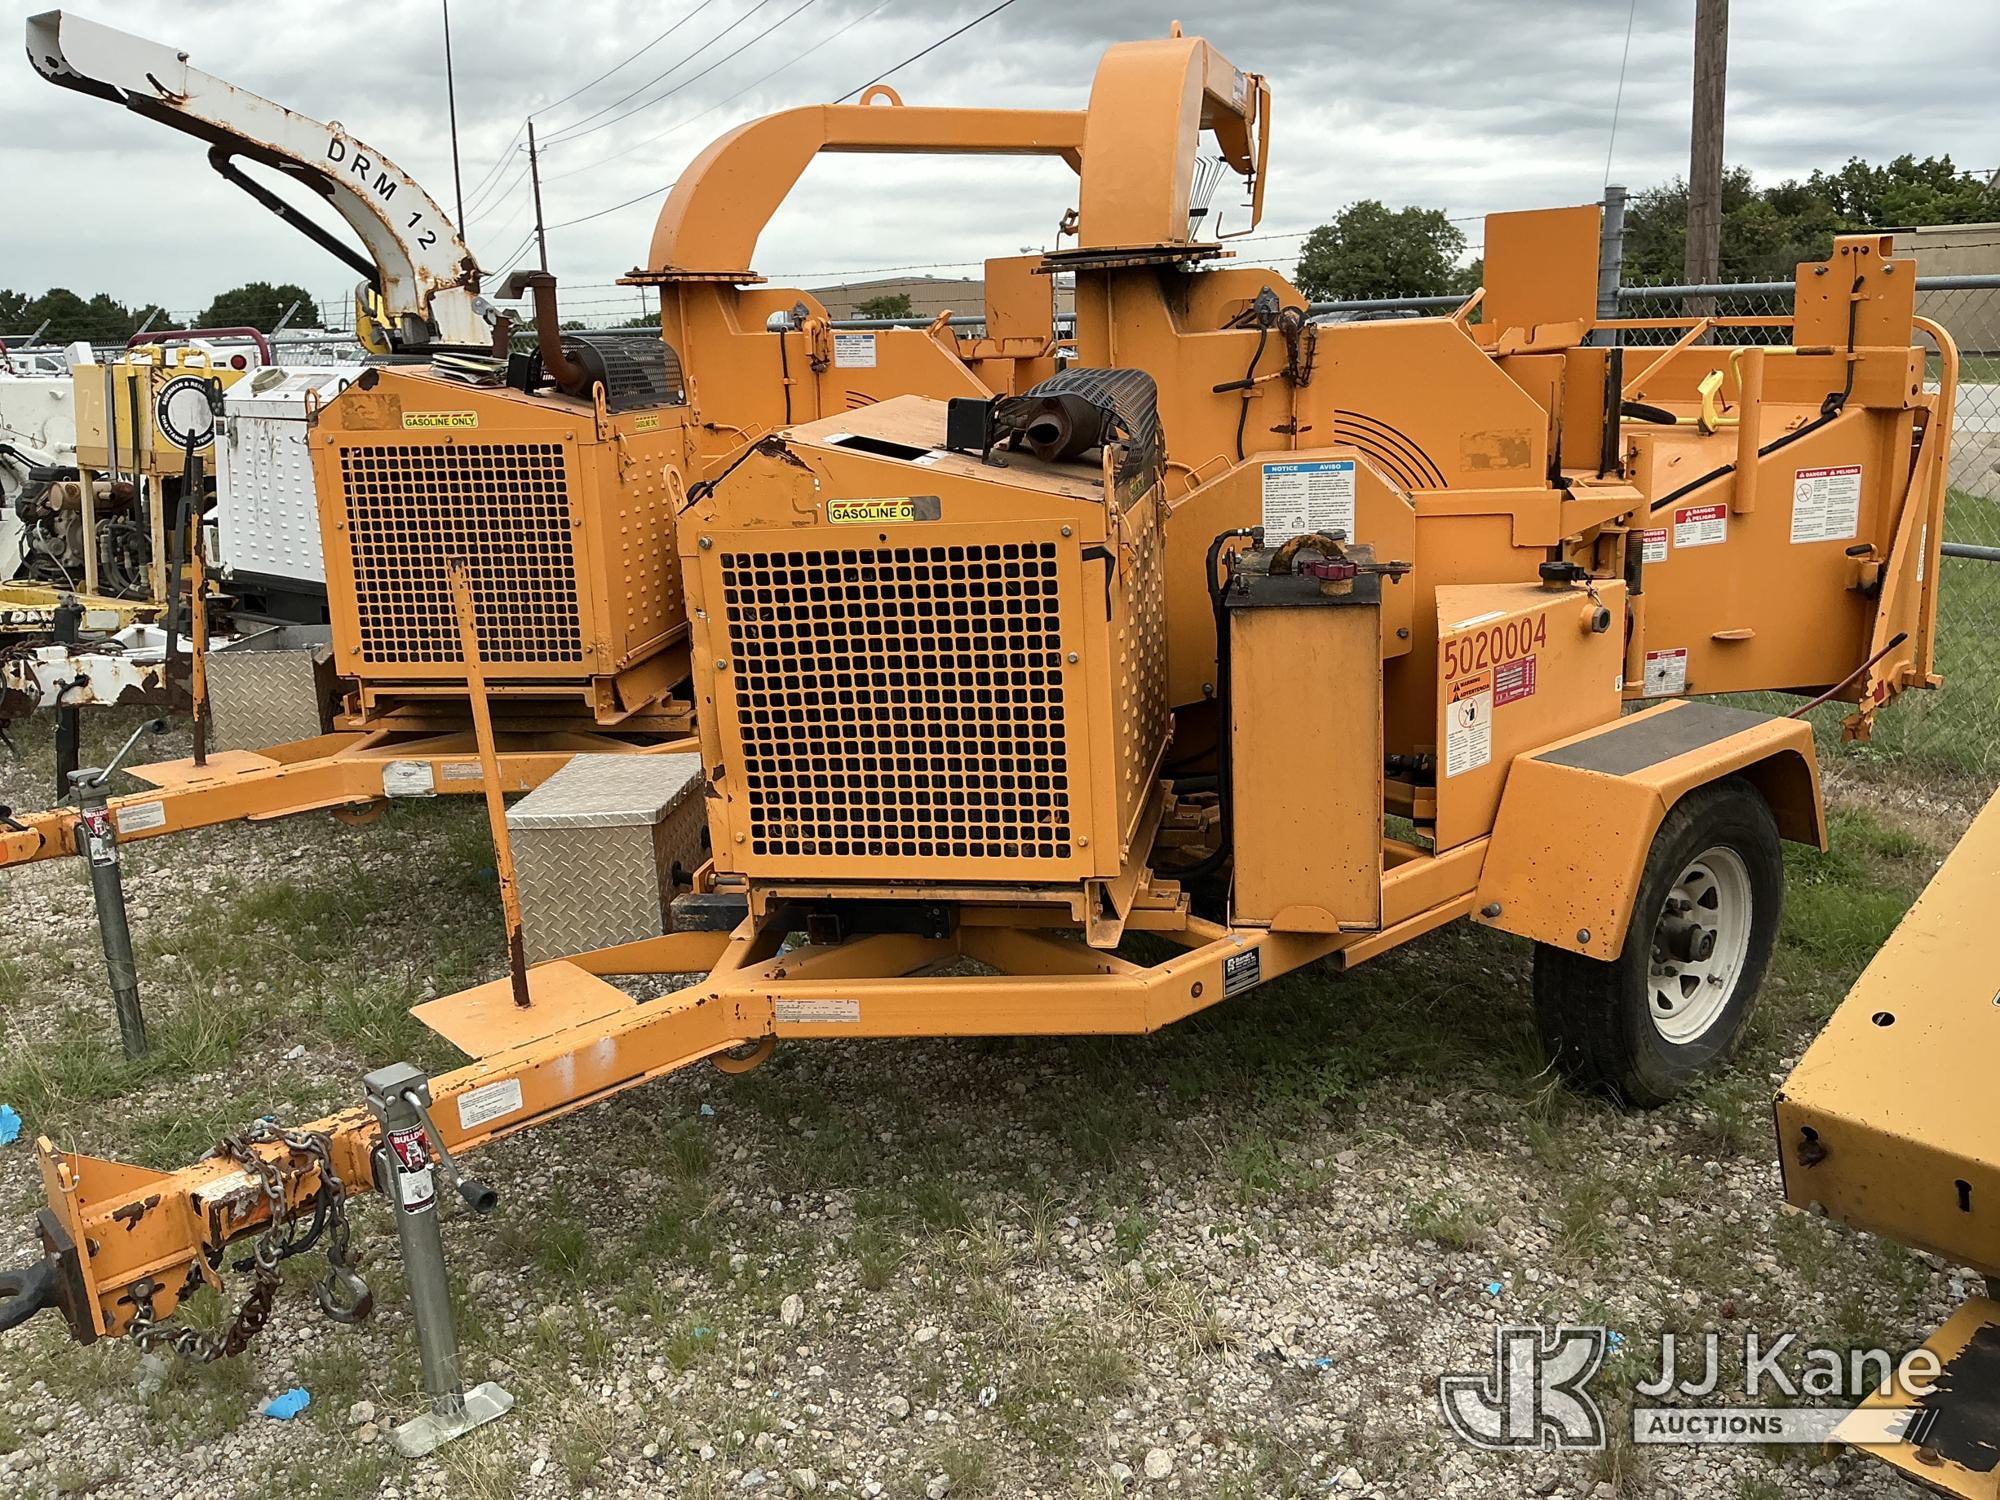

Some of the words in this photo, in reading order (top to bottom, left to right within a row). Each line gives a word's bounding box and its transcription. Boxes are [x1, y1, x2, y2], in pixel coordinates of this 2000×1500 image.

[327, 137, 398, 202] DRM
[407, 212, 437, 251] 12
[191, 381, 206, 392] REILL
[405, 418, 450, 426] GASOLINE
[451, 417, 475, 426] ONLY
[832, 507, 897, 520] GASOLINE
[1692, 513, 1716, 521] PELIGRO
[10, 610, 55, 623] DAW
[1444, 612, 1547, 680] 5020004
[393, 1128, 425, 1144] BULLDO
